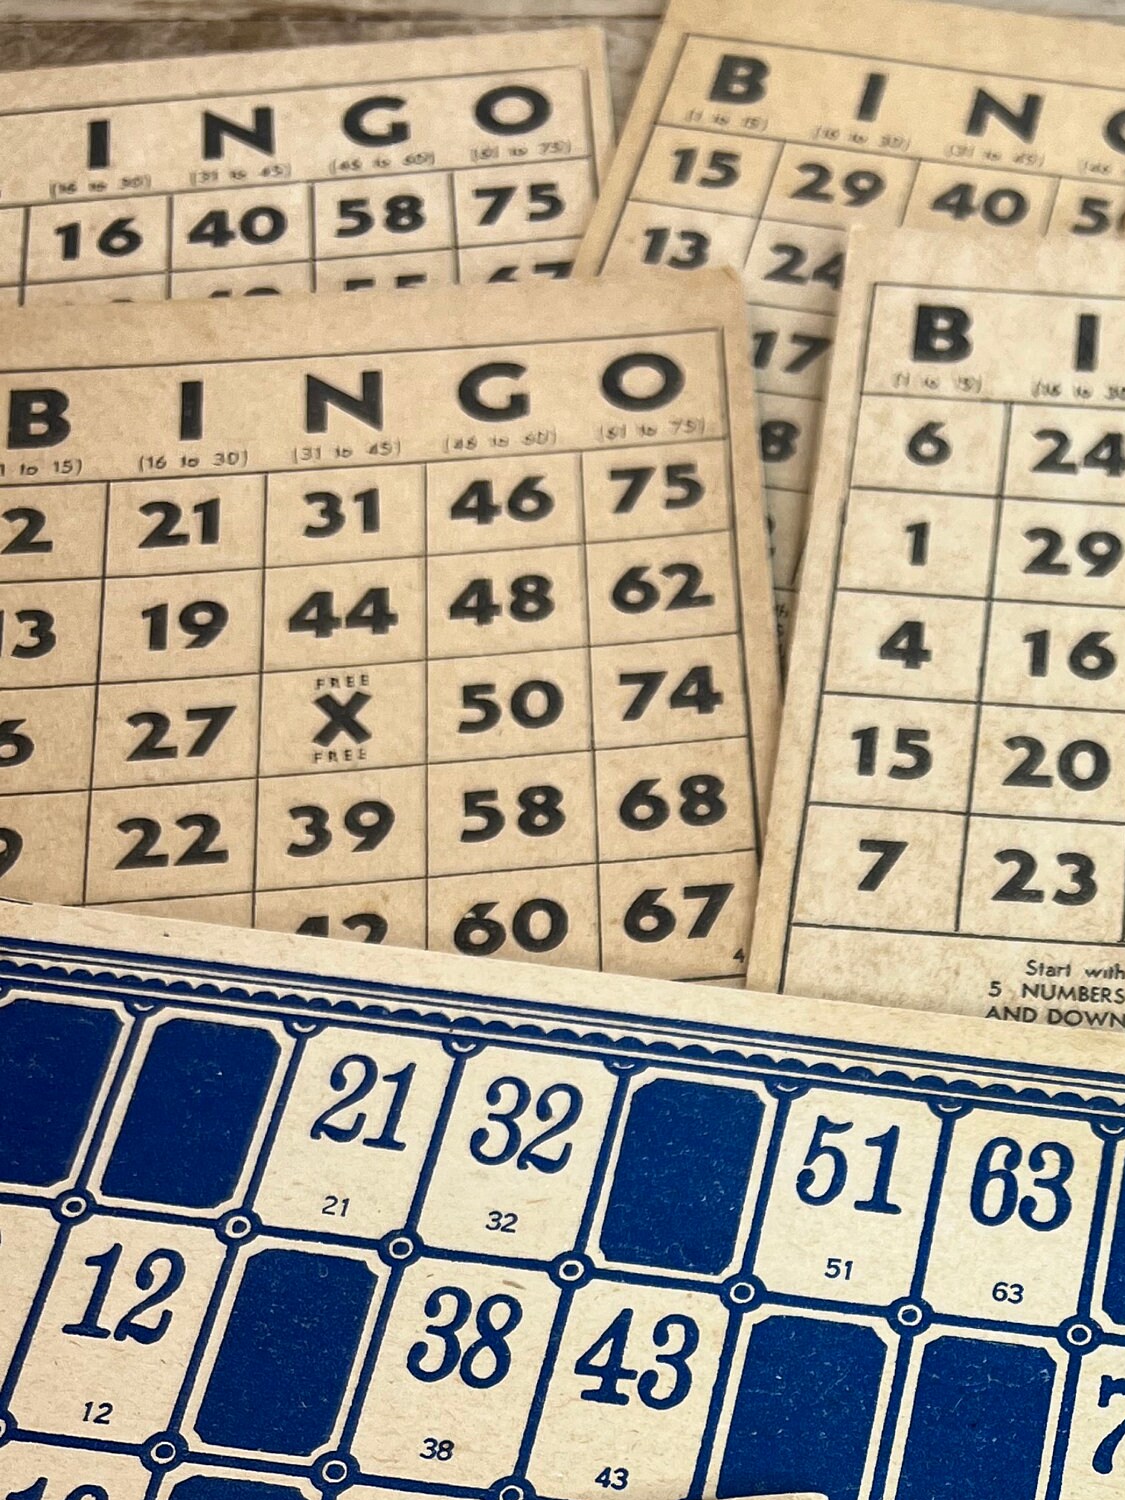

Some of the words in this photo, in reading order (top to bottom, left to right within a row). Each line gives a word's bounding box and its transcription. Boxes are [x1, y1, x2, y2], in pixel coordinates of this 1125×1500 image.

[55, 218, 142, 260] 16
[188, 206, 287, 247] 40
[337, 195, 425, 237] 58
[474, 183, 564, 225] 75
[673, 148, 740, 188] 15
[791, 162, 885, 207] 29
[931, 183, 1028, 226] 40
[644, 228, 709, 270] 13
[907, 421, 951, 465] 6
[139, 498, 219, 548] 21
[304, 488, 379, 538] 31
[451, 476, 553, 524] 46
[609, 463, 704, 513] 75
[906, 522, 929, 565] 1
[1023, 527, 1123, 577] 29
[142, 600, 228, 650] 19
[288, 587, 398, 638] 44
[449, 574, 554, 625] 48
[611, 563, 714, 613] 62
[880, 621, 931, 669] 4
[1024, 629, 1116, 680] 16
[127, 706, 236, 761] 27
[458, 680, 563, 733] 50
[619, 665, 723, 721] 74
[313, 691, 371, 746] X
[852, 727, 931, 779] 15
[1002, 736, 1110, 791] 20
[115, 814, 228, 869] 22
[287, 801, 395, 857] 39
[461, 785, 565, 842] 58
[619, 774, 727, 831] 68
[858, 839, 908, 891] 7
[991, 849, 1097, 905] 23
[453, 898, 568, 956] 60
[624, 883, 734, 942] 67
[989, 981, 1001, 997] 5
[1022, 983, 1125, 1004] NUMBERS
[1025, 959, 1071, 977] Start
[1085, 963, 1125, 979] with
[985, 1006, 1038, 1023] AND
[310, 1054, 416, 1151] 21
[470, 1076, 583, 1173] 32
[796, 1115, 901, 1214] 51
[970, 1137, 1074, 1231] 63
[322, 1196, 349, 1217] 21
[486, 1211, 518, 1233] 32
[825, 1258, 853, 1280] 51
[992, 1282, 1024, 1304] 63
[62, 1243, 185, 1344] 12
[407, 1286, 522, 1389] 38
[574, 1308, 699, 1410] 43
[83, 1402, 113, 1424] 12
[420, 1438, 454, 1461] 38
[595, 1467, 628, 1490] 43
